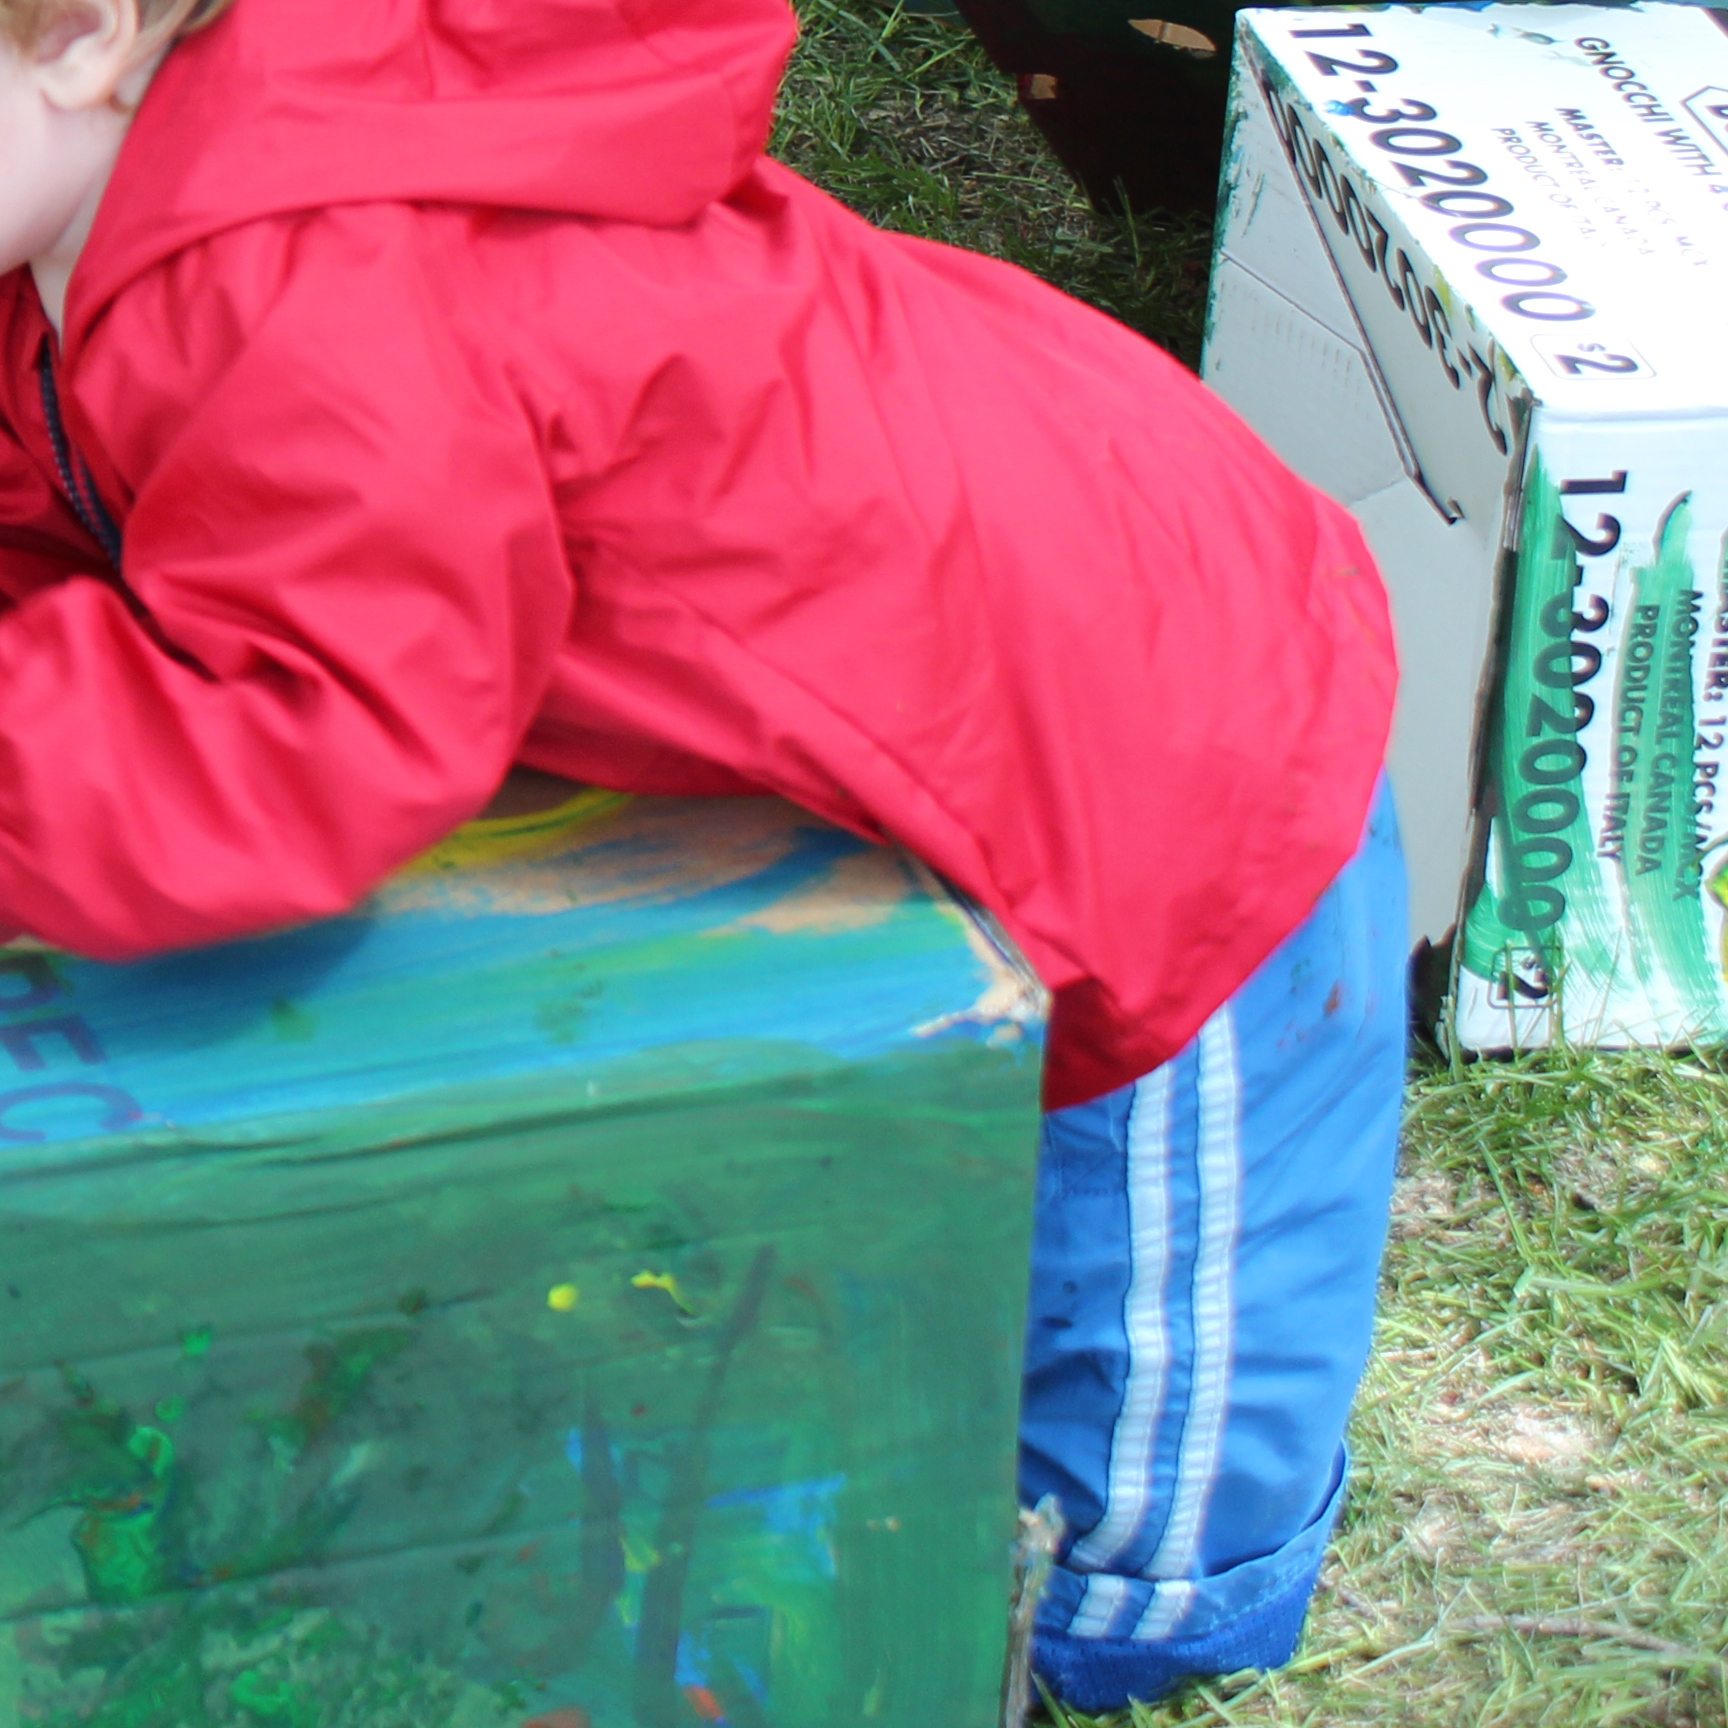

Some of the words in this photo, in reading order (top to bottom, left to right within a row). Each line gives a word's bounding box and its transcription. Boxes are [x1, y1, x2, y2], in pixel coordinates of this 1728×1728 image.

[1287, 22, 1597, 321] 12-3020000
[1573, 36, 1673, 125] GNOCCHI
[1654, 124, 1722, 182] WITH
[1554, 341, 1640, 376] $2
[1495, 469, 1629, 933] 12-3020000
[1616, 604, 1661, 737] PRODUCT
[1653, 588, 1704, 747] MONTREAL
[1609, 744, 1638, 784] OF
[1694, 714, 1727, 752] 12
[1595, 791, 1632, 864] ITALY
[1634, 751, 1677, 876] CANADA
